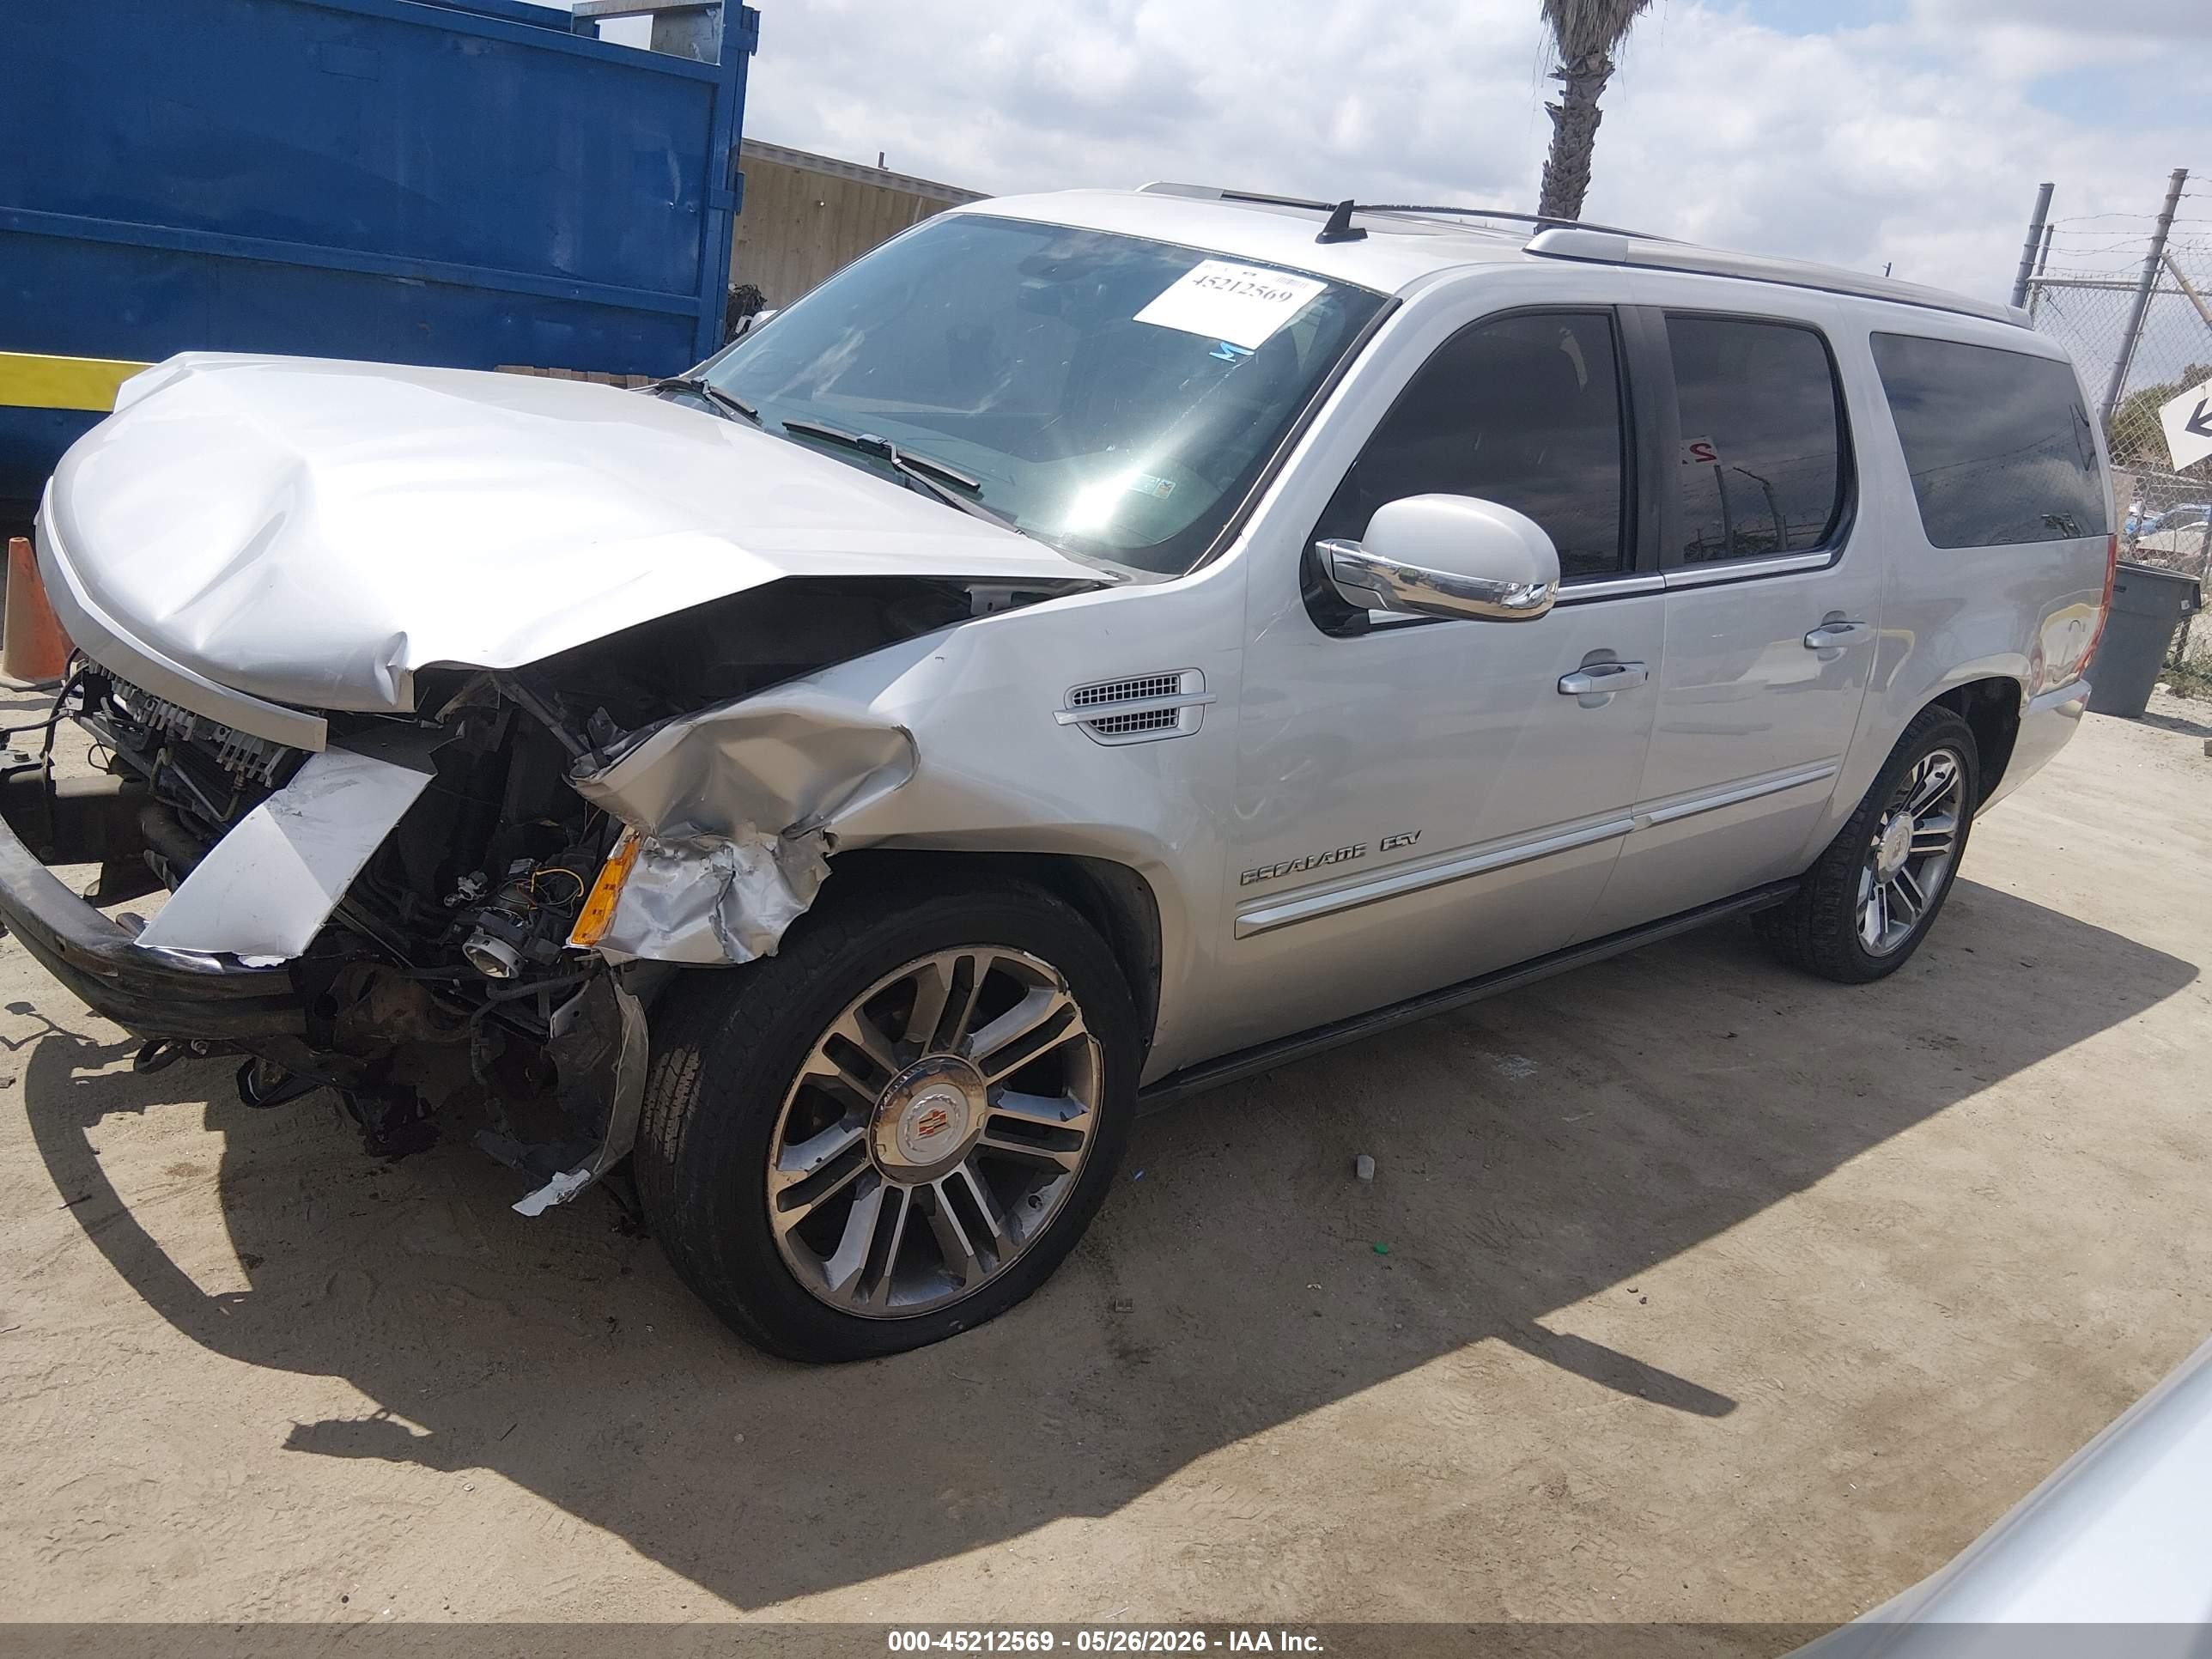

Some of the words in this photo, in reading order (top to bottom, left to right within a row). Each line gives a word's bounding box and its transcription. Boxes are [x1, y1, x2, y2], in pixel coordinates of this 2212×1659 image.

[1193, 275, 1293, 303] 45212569
[1240, 842, 1368, 886] ESCALADE
[1380, 830, 1423, 852] ESV
